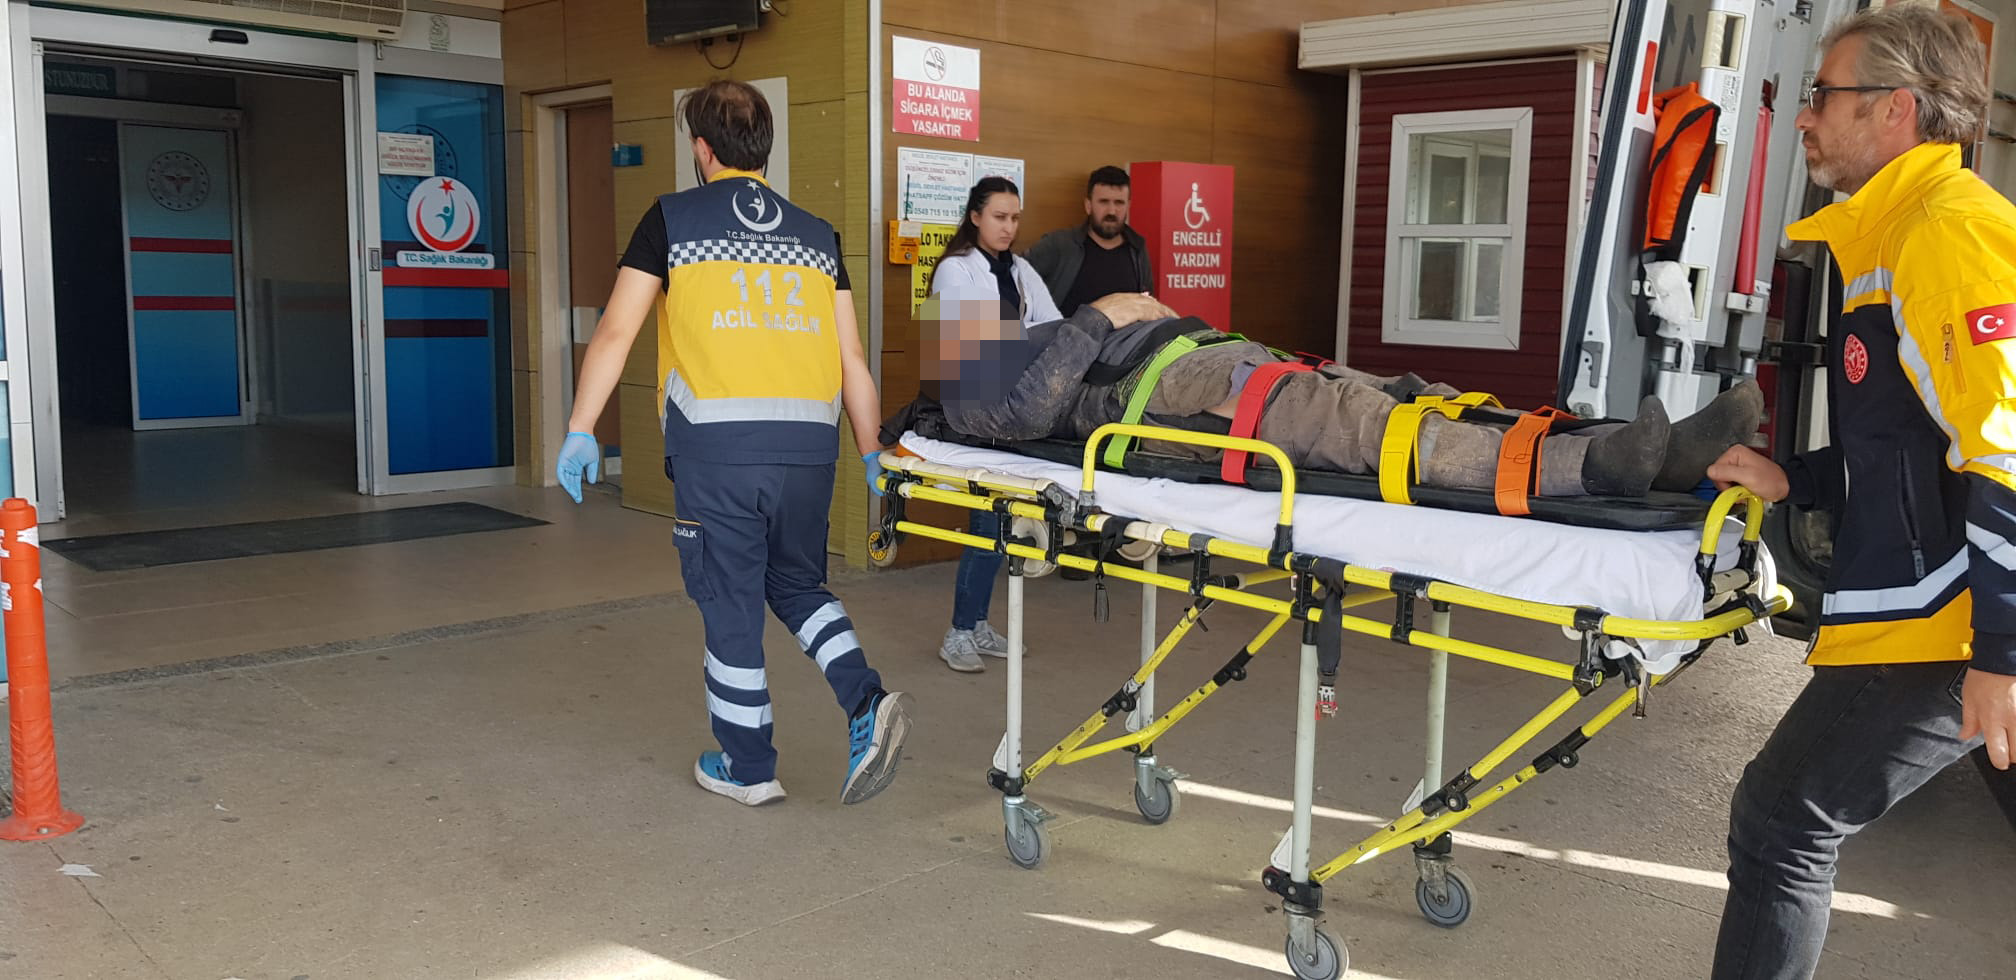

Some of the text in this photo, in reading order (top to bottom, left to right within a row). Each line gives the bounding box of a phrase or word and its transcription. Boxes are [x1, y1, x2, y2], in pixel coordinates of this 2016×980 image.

[908, 83, 966, 103] BU ALANDA
[900, 98, 973, 122] SİGARA İÇMEK
[912, 120, 962, 137] YASAKTIR
[920, 233, 931, 247] LO
[1172, 229, 1222, 247] ENGELLİ
[419, 253, 447, 265] Sağlık
[448, 255, 489, 267] Bakanlığı
[1173, 252, 1220, 268] YARDIM
[730, 267, 805, 307] 112
[1166, 274, 1225, 289] TELEFONU
[712, 304, 758, 331] ACİL
